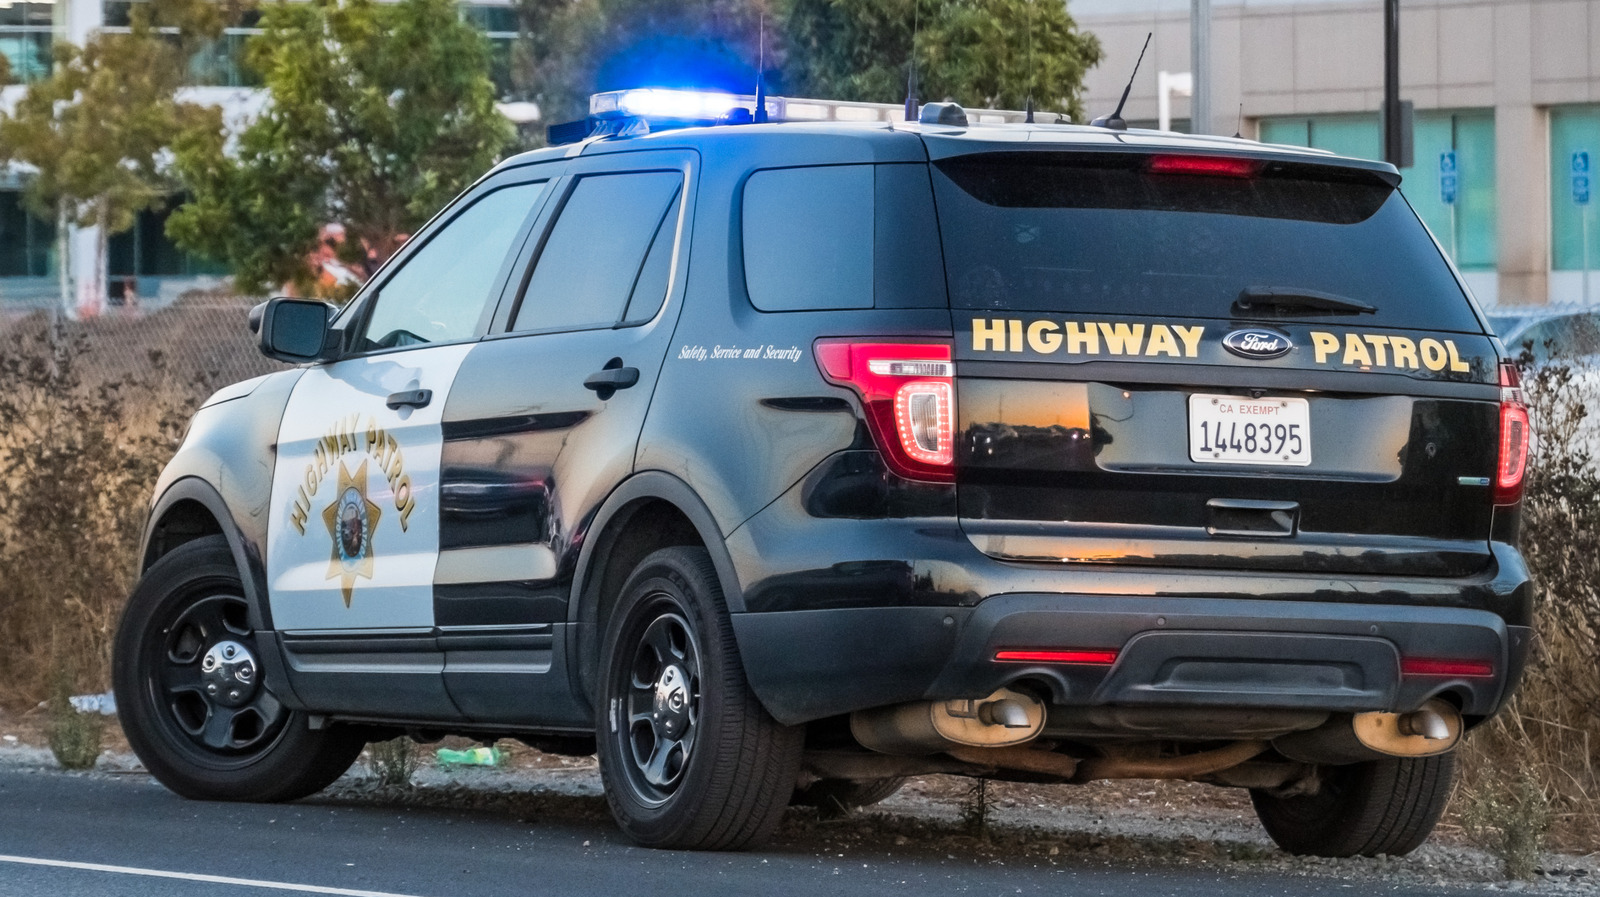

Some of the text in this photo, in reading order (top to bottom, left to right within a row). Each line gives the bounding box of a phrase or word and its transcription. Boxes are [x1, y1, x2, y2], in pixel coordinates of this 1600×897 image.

[678, 344, 802, 363] Safety, Service and Security
[972, 318, 1205, 357] HIGHWAY
[1240, 333, 1279, 351] Ford
[1310, 331, 1470, 373] PATROL
[1219, 403, 1280, 416] CA EXEMPT
[1200, 420, 1302, 455] 1448395
[291, 412, 415, 536] HIGHWAY PATROL
